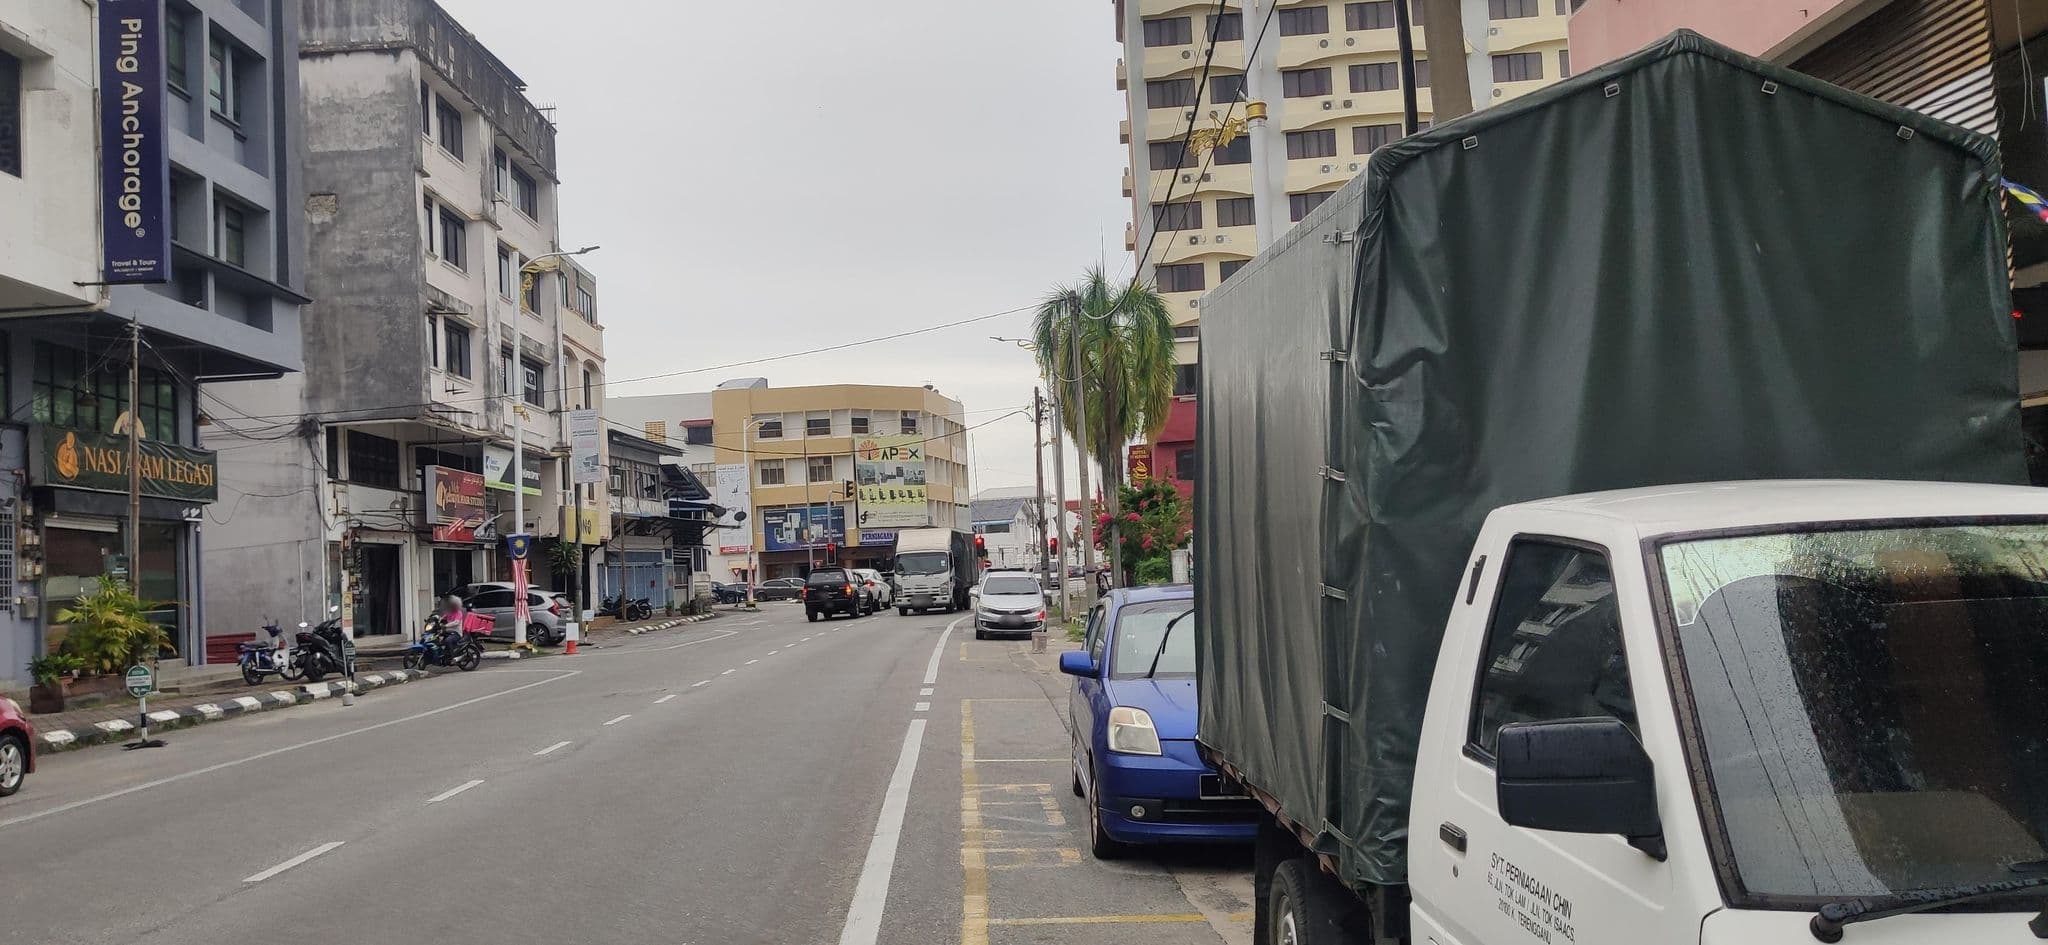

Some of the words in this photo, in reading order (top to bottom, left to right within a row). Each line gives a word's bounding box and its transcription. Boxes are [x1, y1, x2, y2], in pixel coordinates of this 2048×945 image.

[115, 18, 142, 73] Ping
[84, 446, 122, 475] NASI
[168, 457, 214, 486] LEGASI
[1505, 861, 1552, 906] PERNIAGAAN
[1553, 893, 1572, 920] CHIN
[1517, 911, 1552, 945] TERENGGANU
[1542, 908, 1553, 927] TOK
